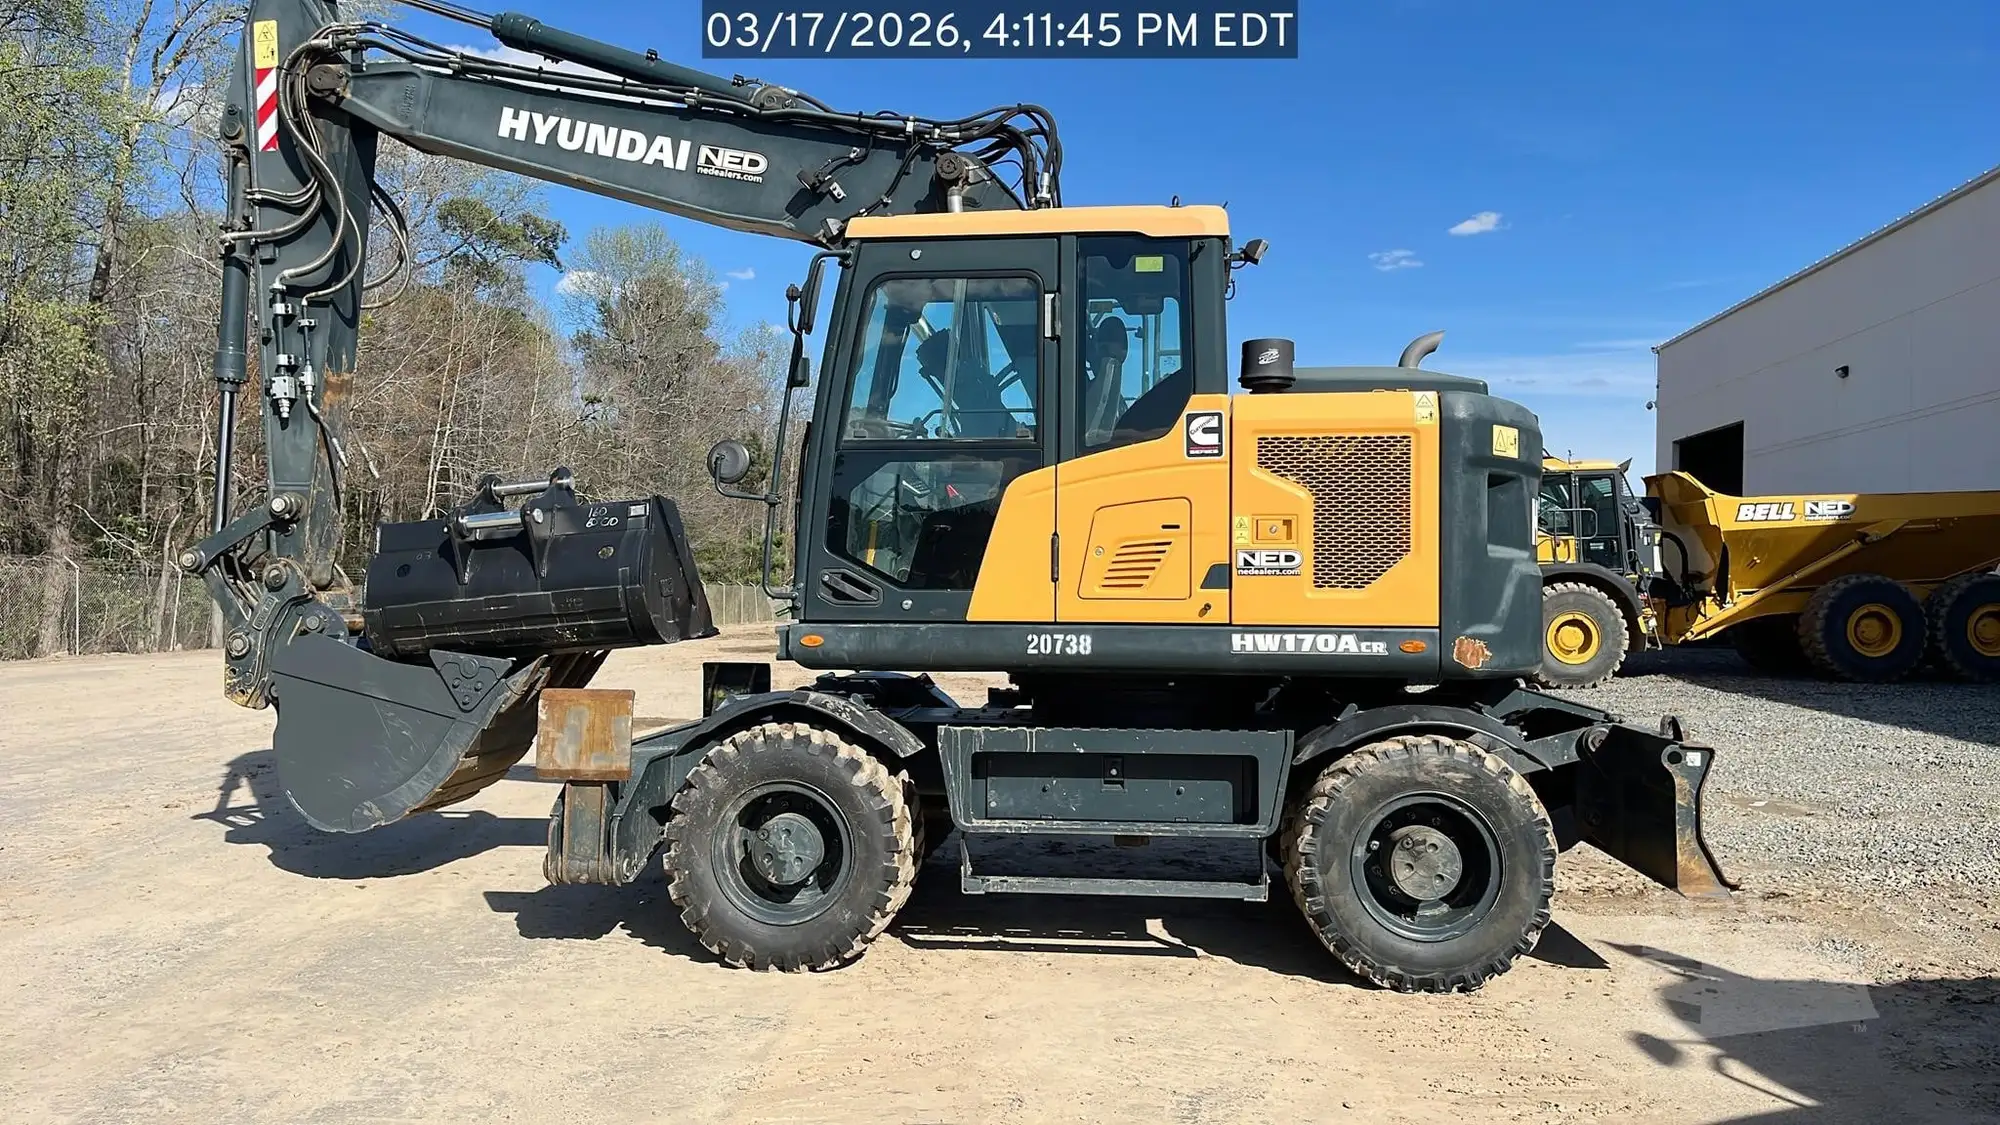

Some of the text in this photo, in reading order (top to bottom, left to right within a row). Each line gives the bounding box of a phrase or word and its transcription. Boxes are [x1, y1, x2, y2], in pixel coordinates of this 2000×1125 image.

[498, 106, 692, 171] HYUNDAI
[697, 145, 768, 174] NED
[697, 166, 763, 183] nedealers.com
[1736, 502, 1796, 521] BELL
[1804, 500, 1856, 516] NED
[1237, 550, 1304, 568] NED
[1238, 567, 1301, 575] nedealers.com
[1026, 633, 1092, 655] 20738
